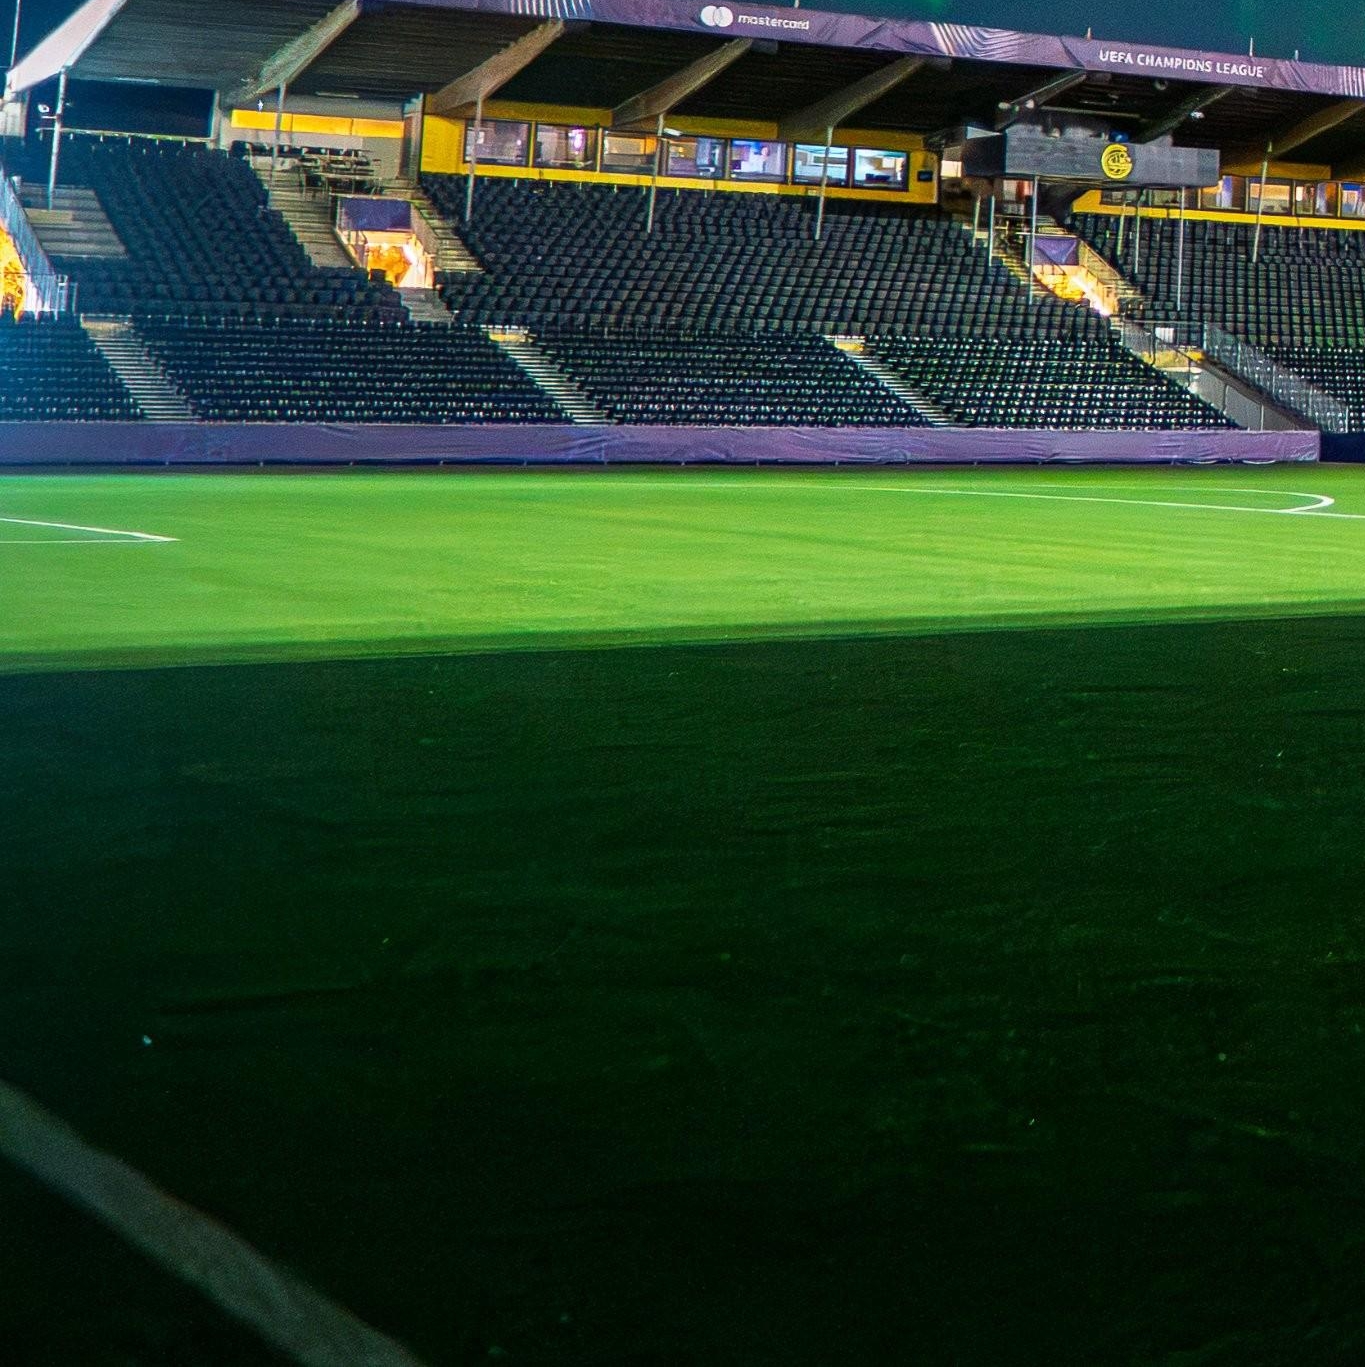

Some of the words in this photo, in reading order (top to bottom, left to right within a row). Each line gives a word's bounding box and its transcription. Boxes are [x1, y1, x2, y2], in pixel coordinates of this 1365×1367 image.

[737, 14, 810, 30] mastercard
[1099, 49, 1134, 65] UEFA
[1137, 53, 1213, 73] CHAMPIONS
[1216, 62, 1264, 78] LEAGUE
